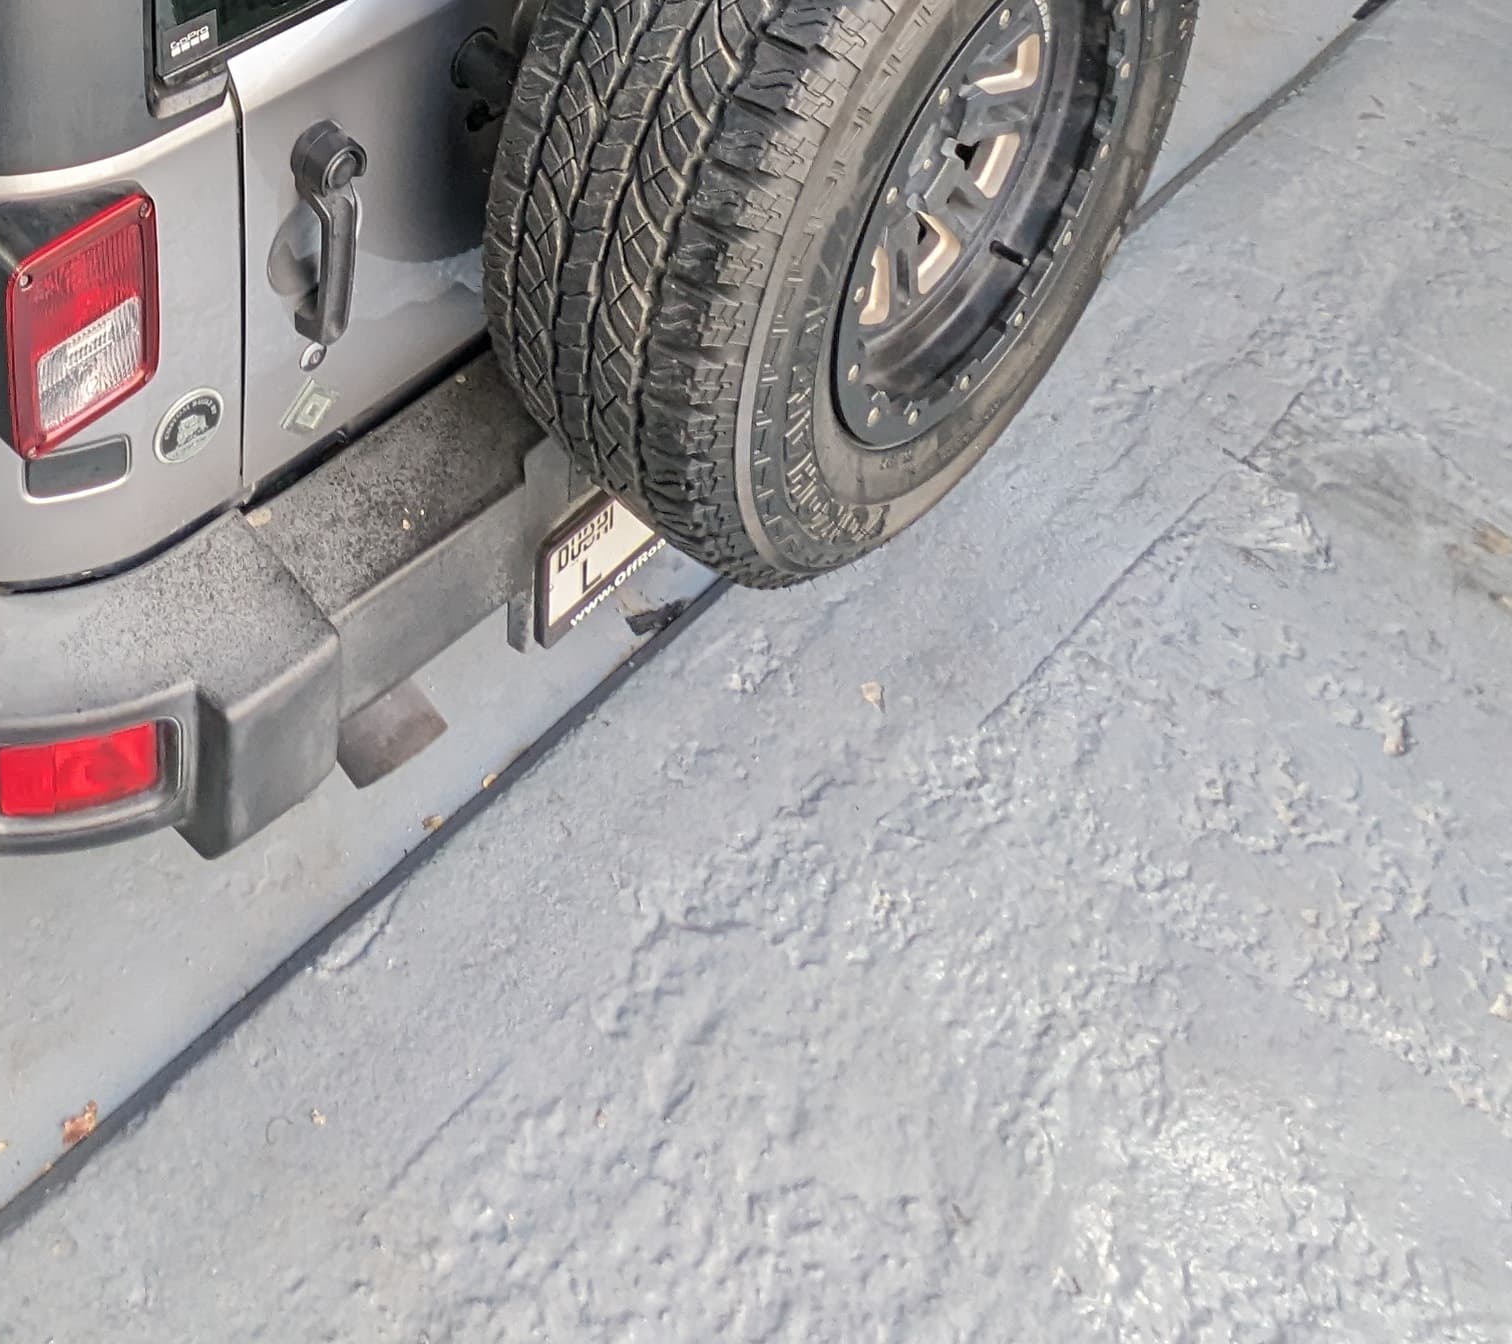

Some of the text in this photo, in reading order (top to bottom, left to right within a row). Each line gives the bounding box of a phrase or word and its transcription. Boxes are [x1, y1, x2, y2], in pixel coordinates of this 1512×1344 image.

[558, 503, 615, 573] DUBAI
[570, 537, 666, 627] www.OffRoa
[582, 558, 602, 593] L
